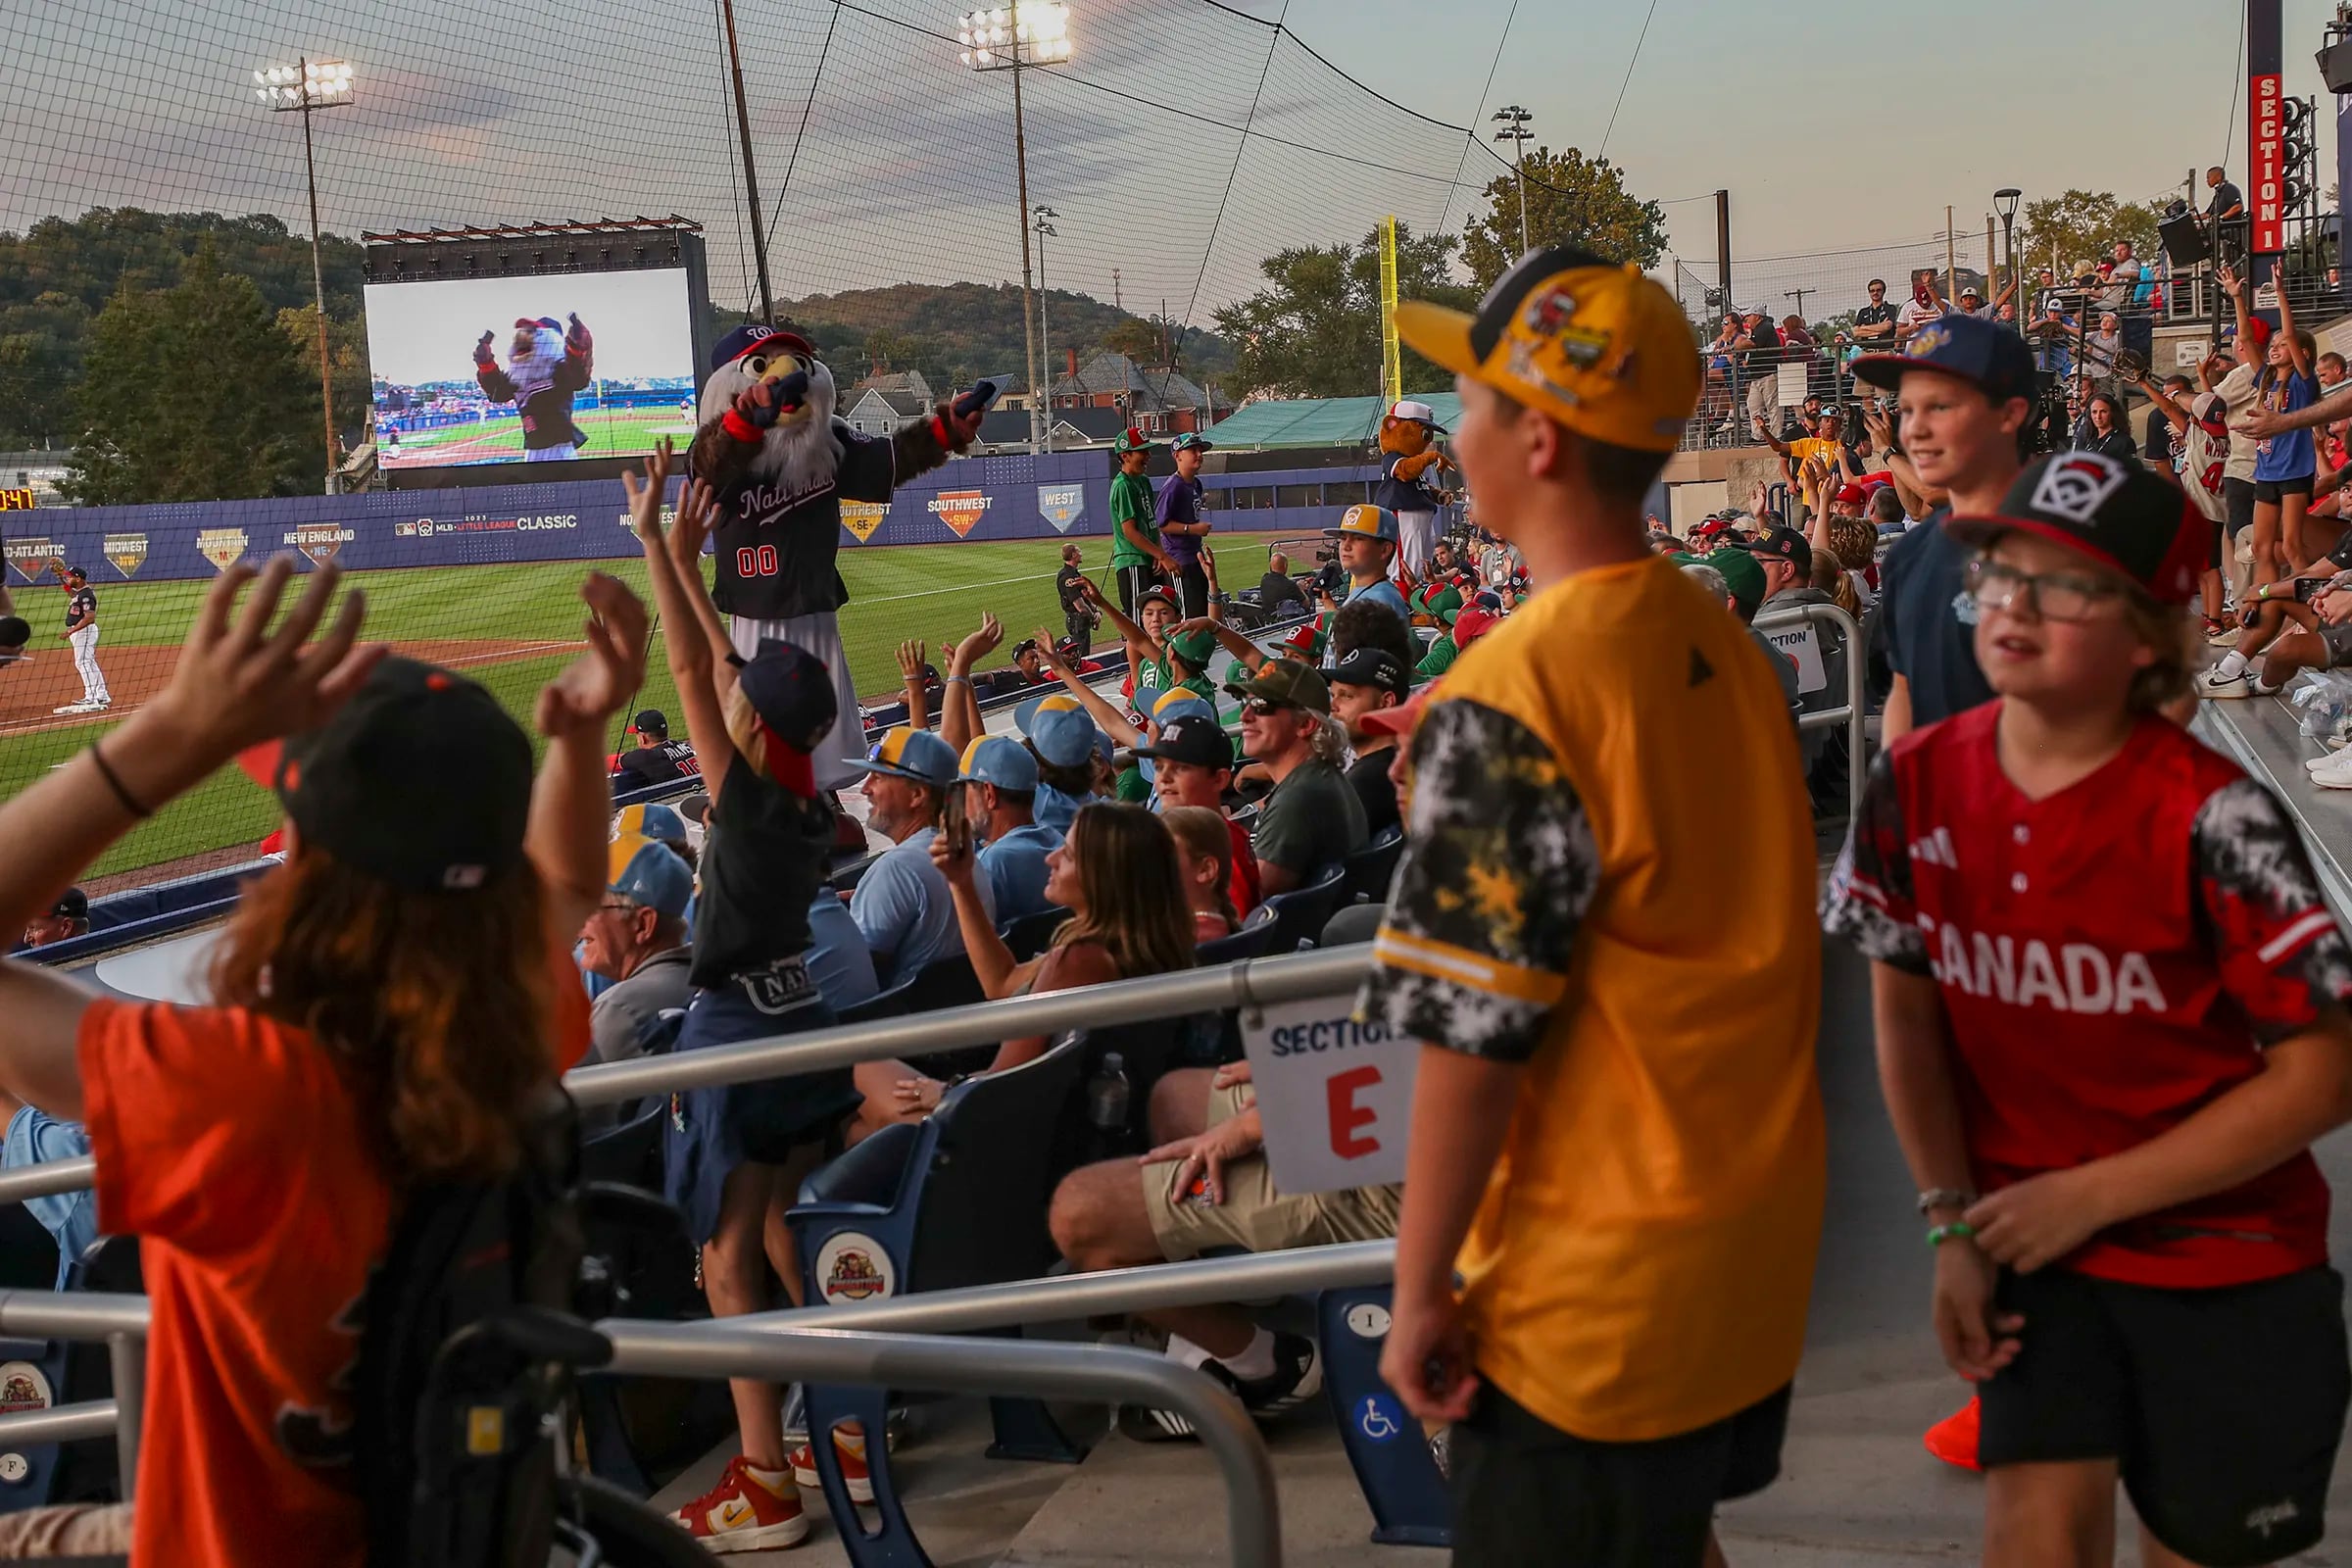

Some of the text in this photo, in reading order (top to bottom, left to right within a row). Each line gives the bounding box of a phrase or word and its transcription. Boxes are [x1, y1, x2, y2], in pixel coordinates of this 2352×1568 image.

[2260, 78, 2277, 221] SECTION
[927, 497, 993, 512] SOUTHWEST
[1045, 492, 1076, 506] WEST
[457, 521, 483, 531] LITTLE
[485, 519, 517, 530] LEAGUE
[857, 519, 868, 530] SE
[953, 514, 970, 525] SW
[196, 535, 249, 549] MOUNTAIN
[283, 528, 355, 545] NEW ENGLAND
[104, 540, 149, 553] MIDWEST
[313, 545, 327, 557] NE
[736, 544, 779, 578] 00
[1916, 912, 2167, 1014] CANADA
[1327, 1063, 1383, 1161] E
[8, 1460, 17, 1473] F
